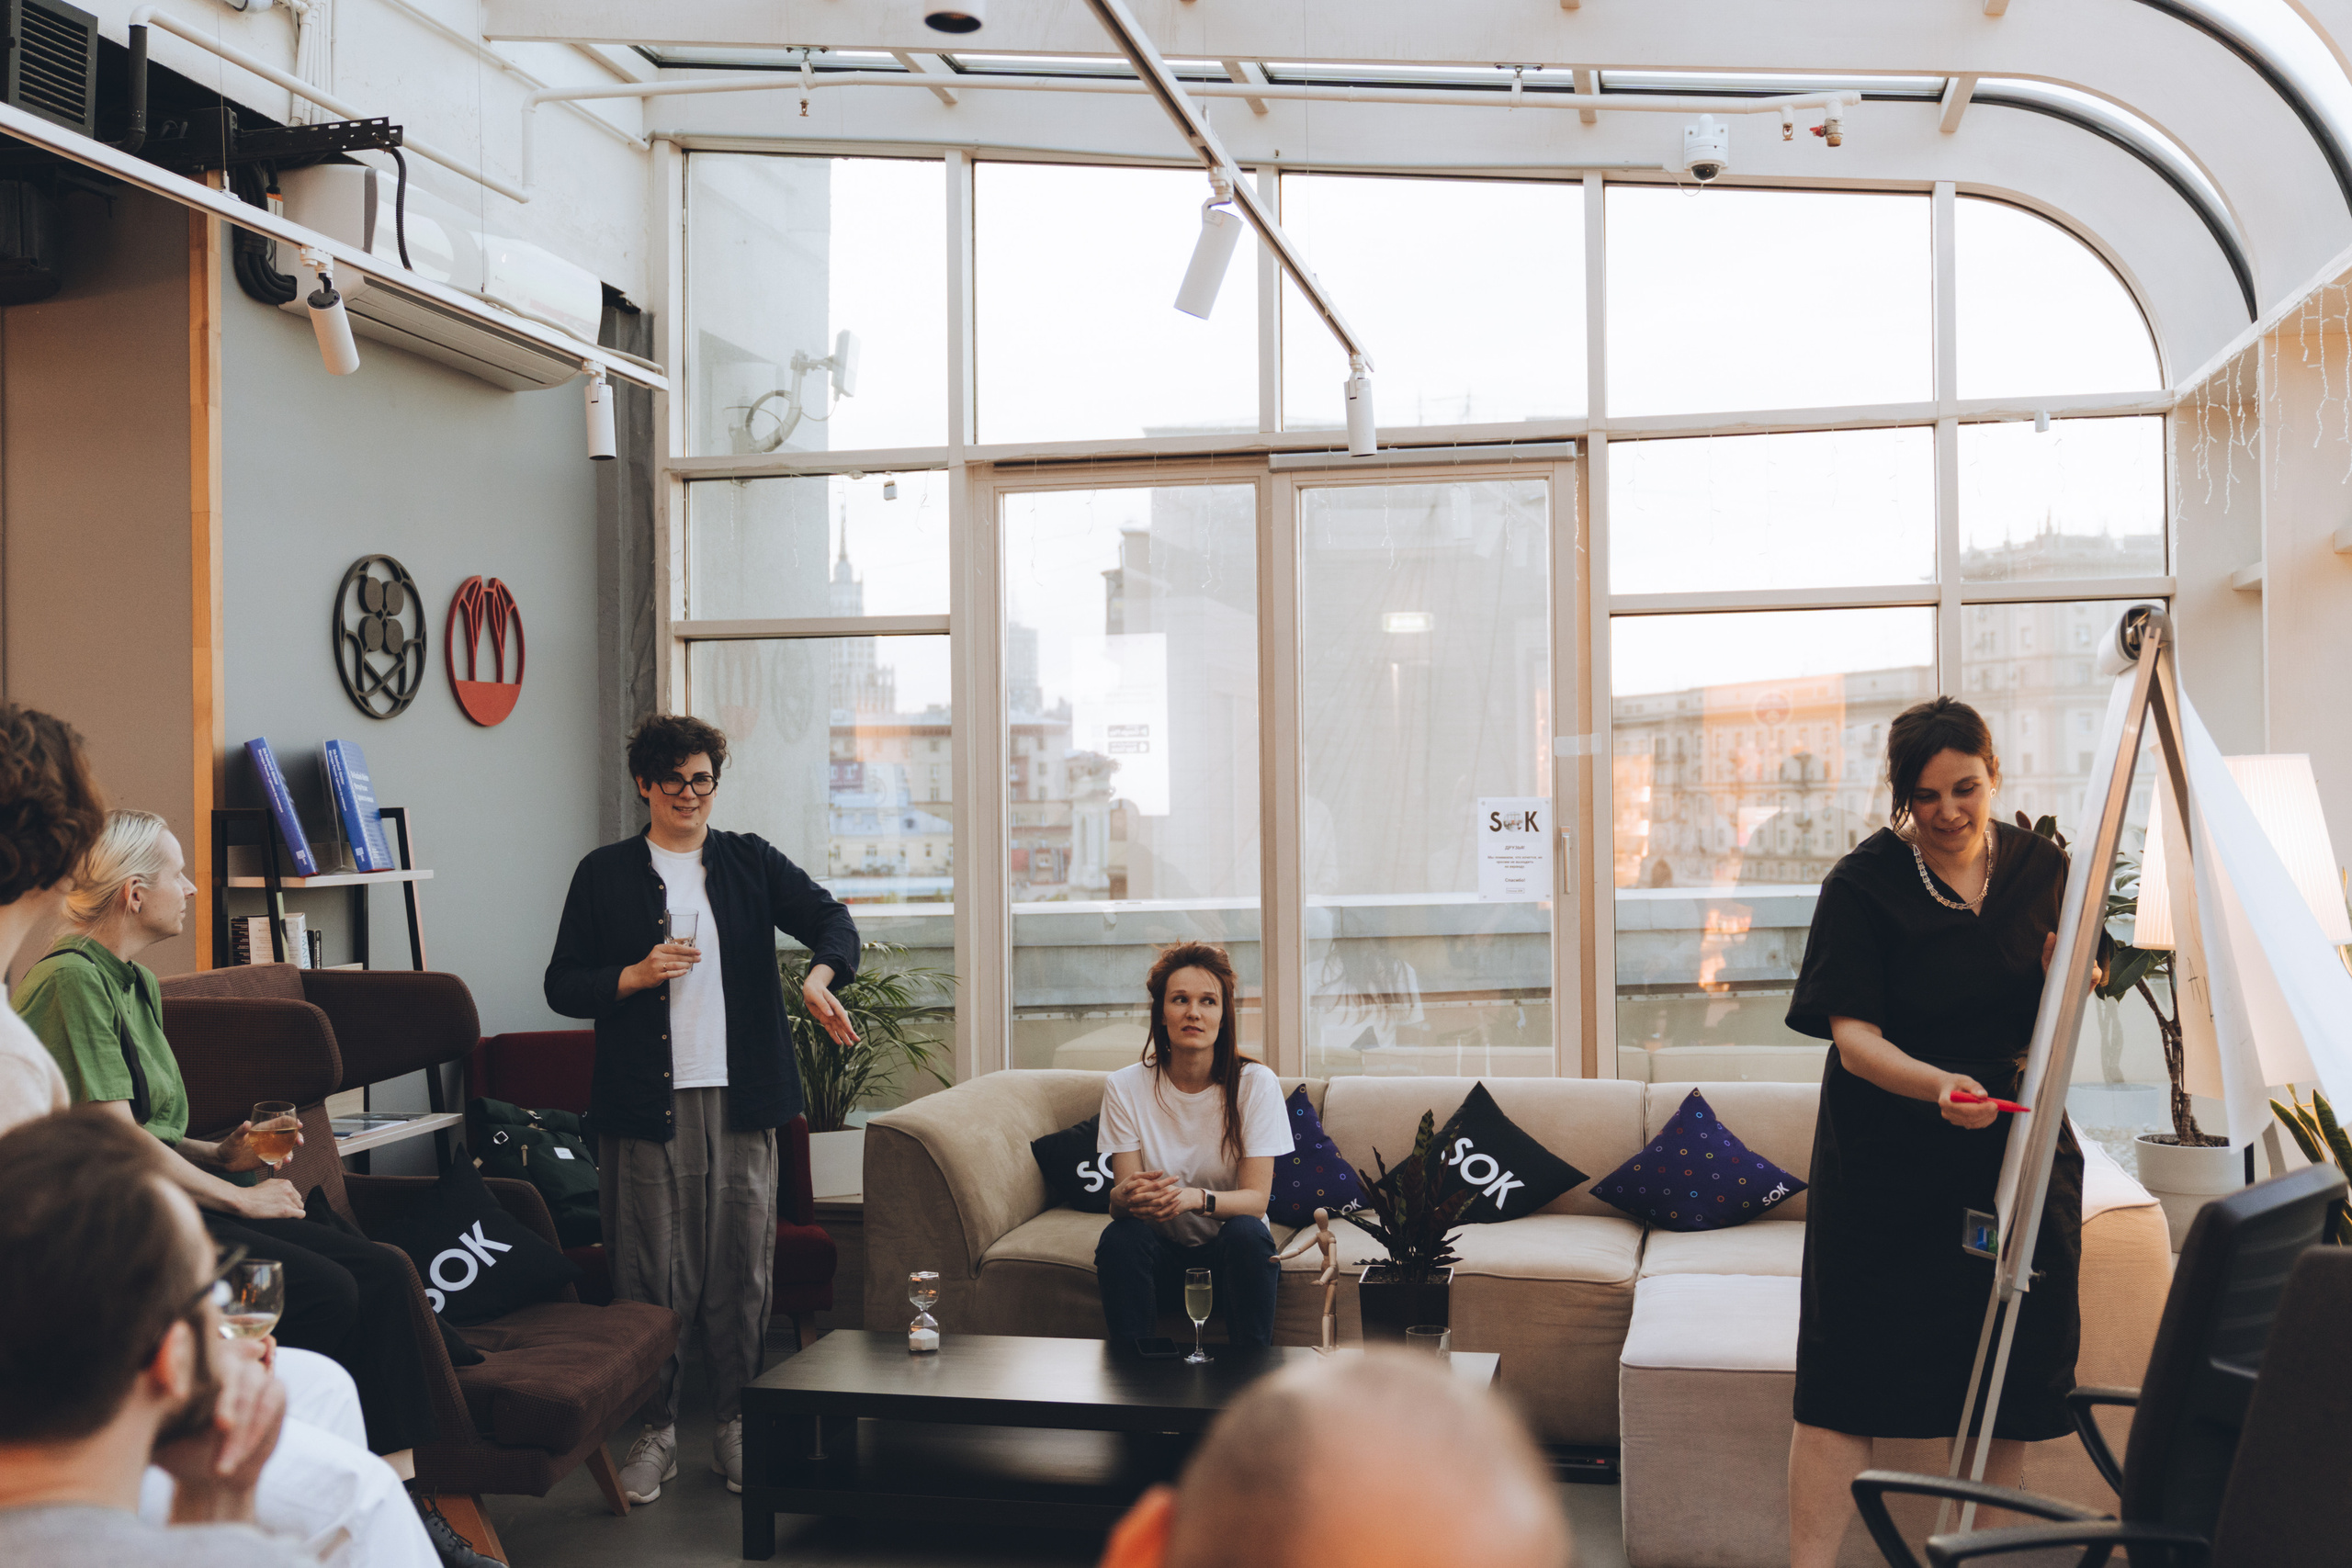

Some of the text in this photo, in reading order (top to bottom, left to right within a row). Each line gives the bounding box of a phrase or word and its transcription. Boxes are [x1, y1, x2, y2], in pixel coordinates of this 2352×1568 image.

[1441, 1137, 1525, 1211] SOK
[1341, 1198, 1363, 1213] OK
[1762, 1181, 1790, 1206] SOK
